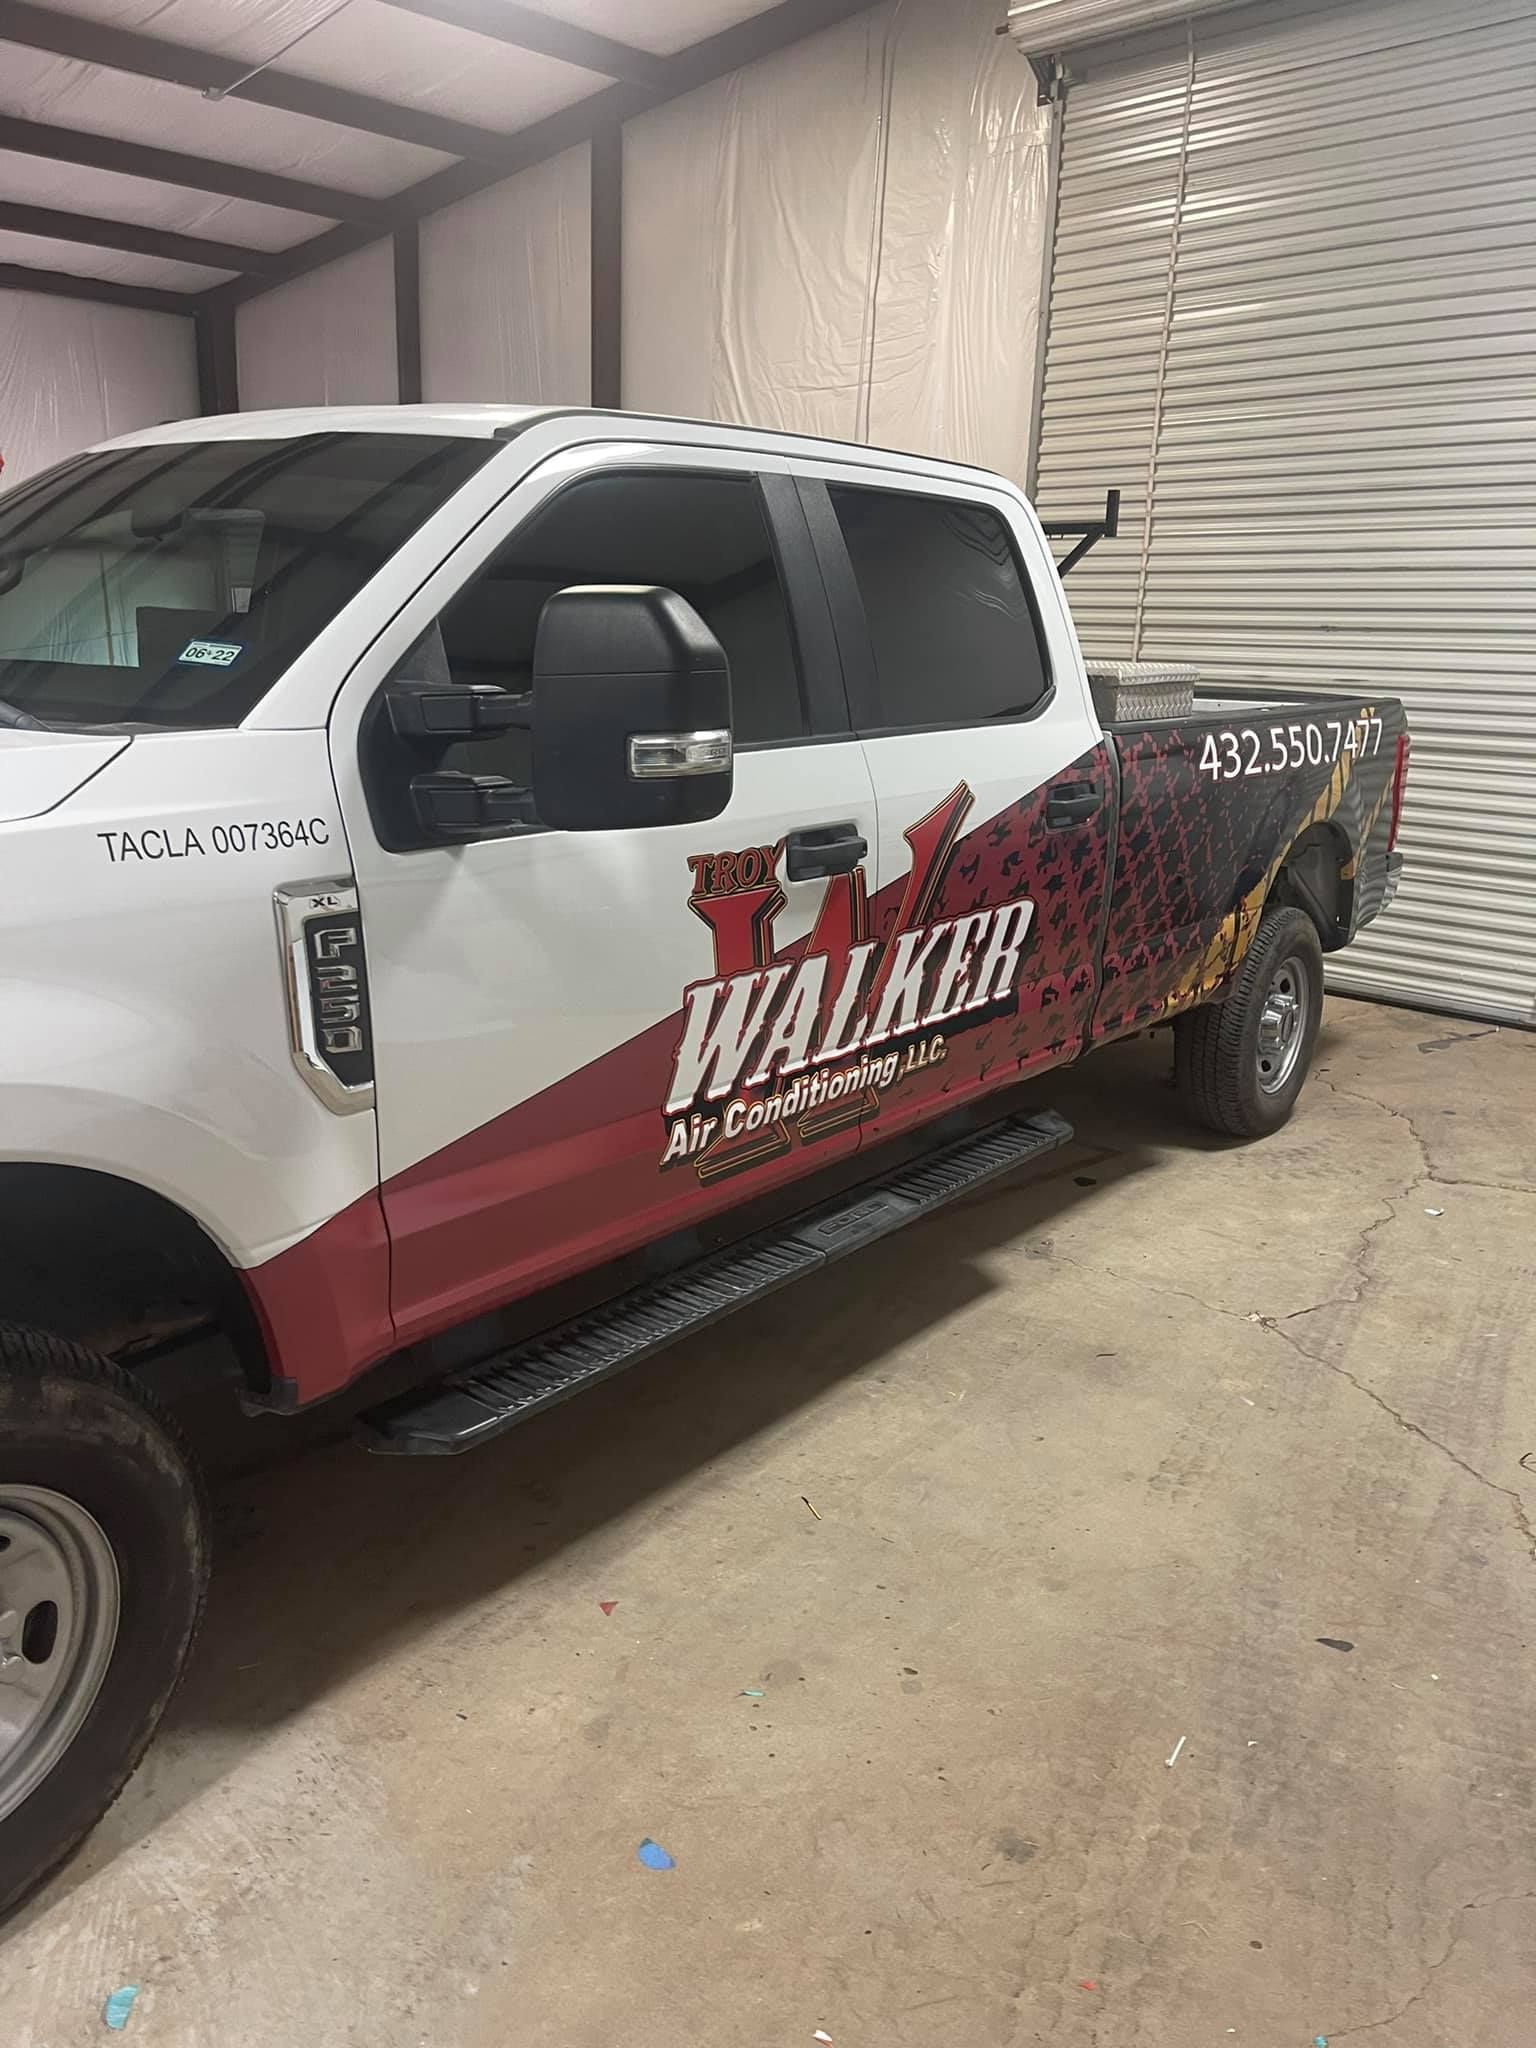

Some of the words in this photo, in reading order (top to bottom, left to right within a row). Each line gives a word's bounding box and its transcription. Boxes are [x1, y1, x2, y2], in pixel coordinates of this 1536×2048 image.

[186, 648, 207, 658] 06
[212, 650, 235, 661] 22
[1200, 718, 1383, 780] 432.550.7477
[97, 827, 206, 862] TACLA
[212, 818, 329, 854] 007364C
[687, 837, 787, 896] TROY
[311, 896, 338, 908] XL
[663, 898, 1036, 1116] WALKER
[659, 1114, 718, 1166] Air
